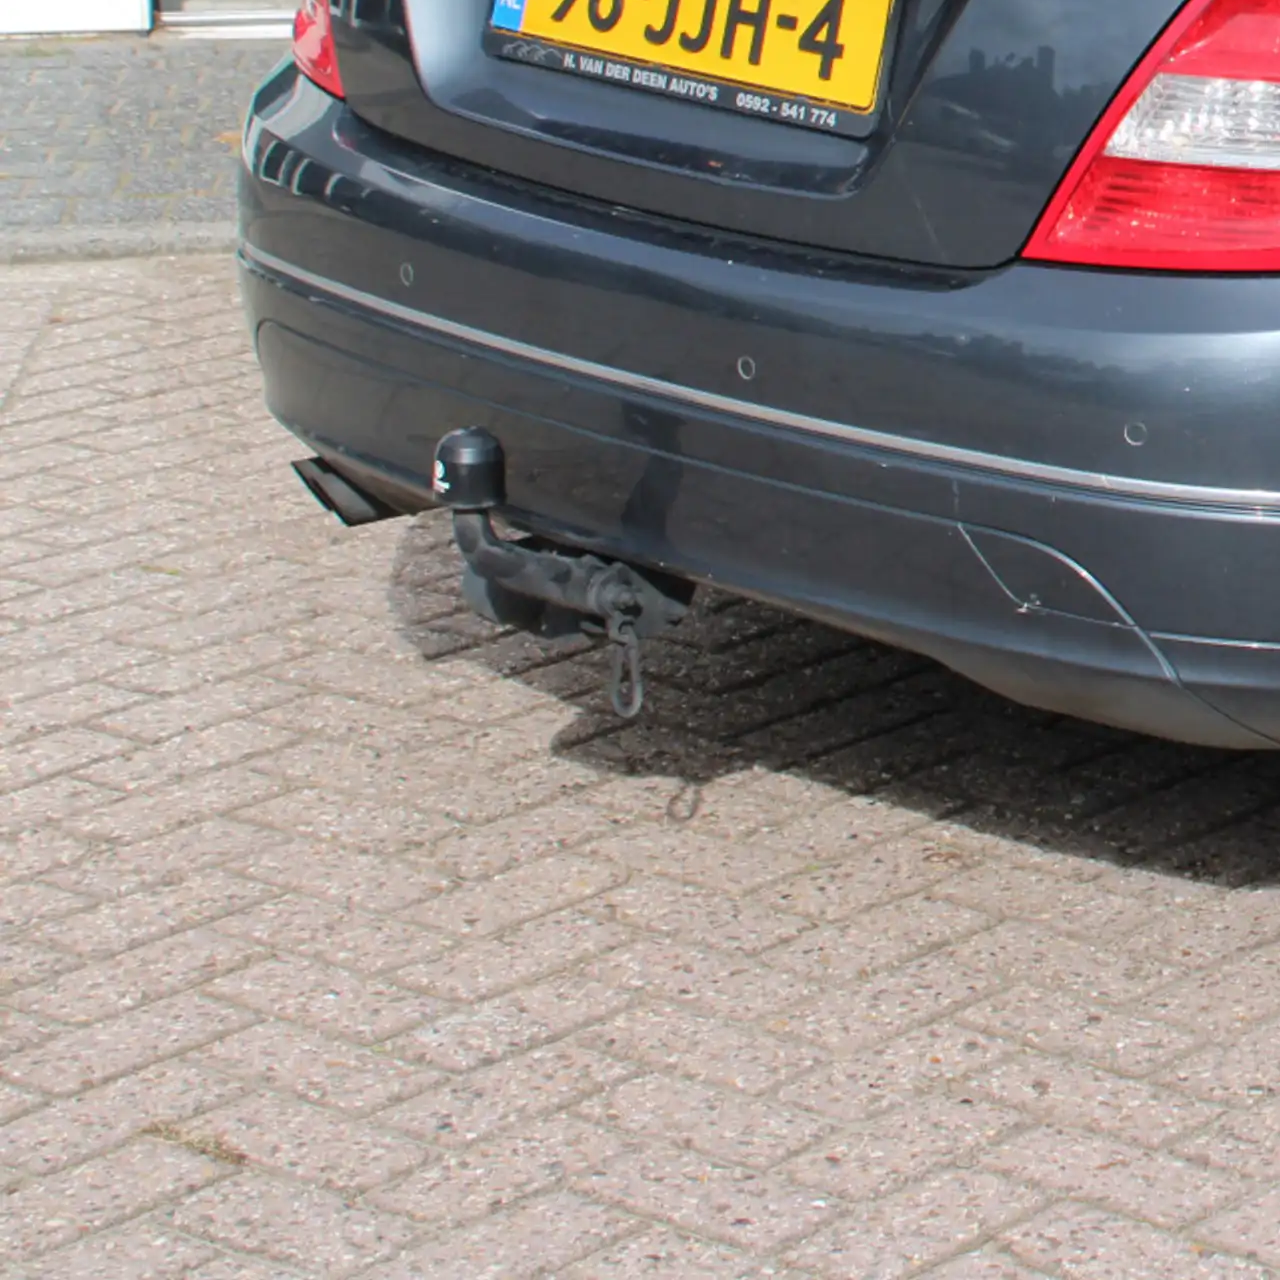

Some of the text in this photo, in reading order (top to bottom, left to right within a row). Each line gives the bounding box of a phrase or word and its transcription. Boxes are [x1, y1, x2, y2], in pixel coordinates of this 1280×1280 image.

[579, 56, 604, 76] VAN
[605, 63, 630, 82] DER
[632, 69, 668, 90] DEEN
[669, 77, 718, 101] AUTO'S
[736, 92, 769, 113] 0592
[781, 102, 806, 120] 541
[810, 108, 836, 127] 774
